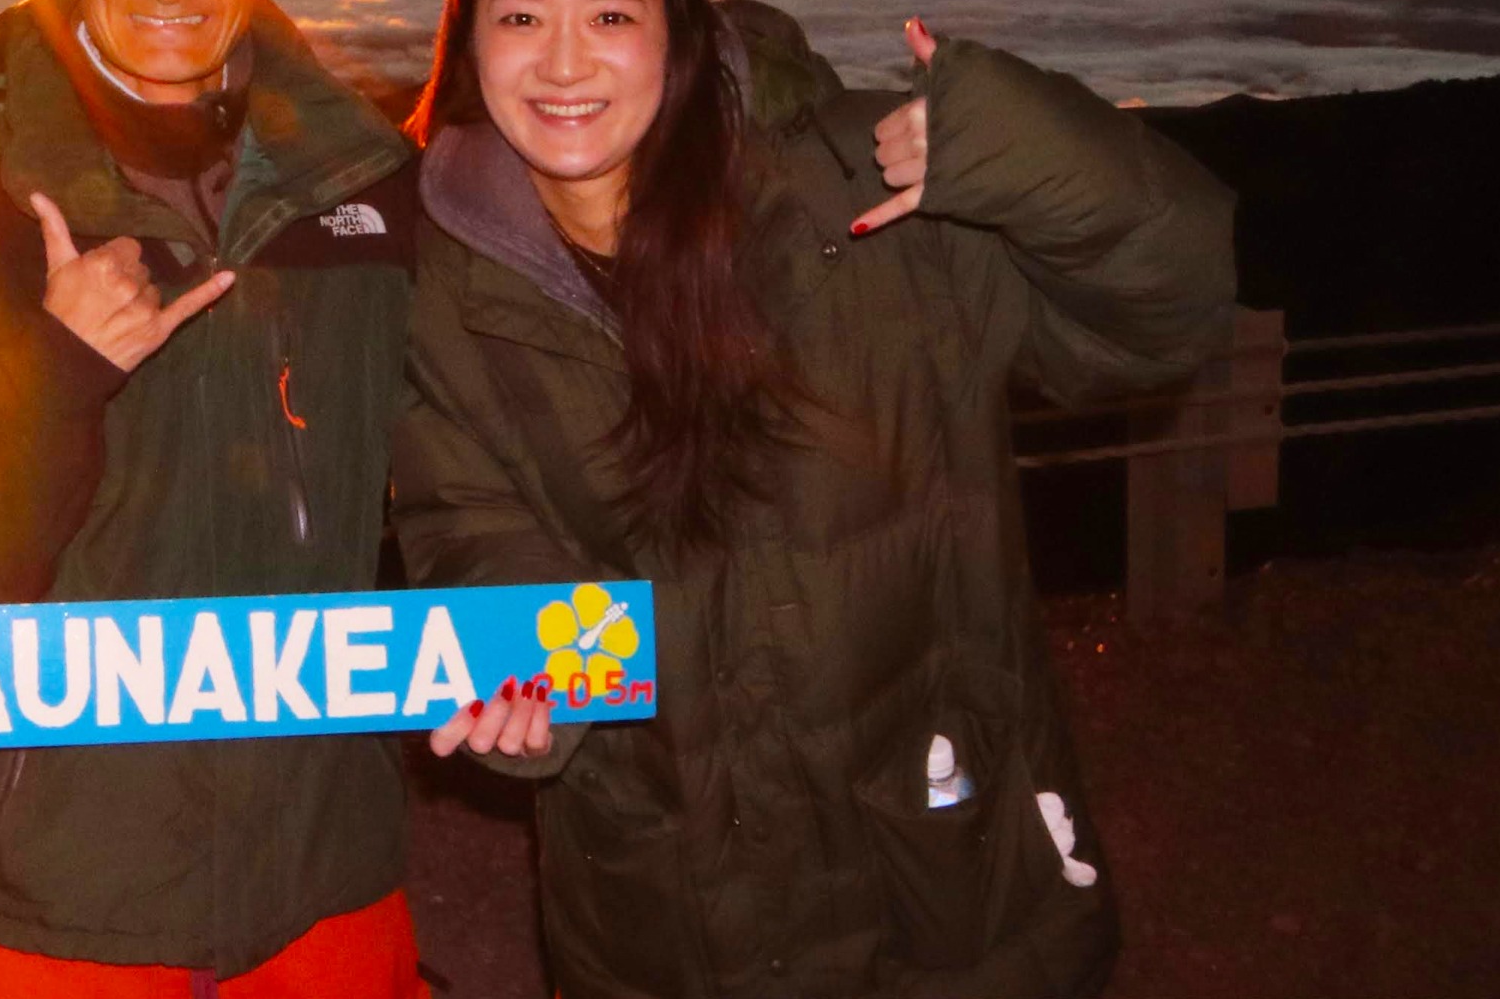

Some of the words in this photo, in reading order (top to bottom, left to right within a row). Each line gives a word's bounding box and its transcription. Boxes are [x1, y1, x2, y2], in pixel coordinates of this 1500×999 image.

[336, 205, 358, 215] THE
[320, 214, 361, 226] NORTH
[332, 225, 364, 236] FACE
